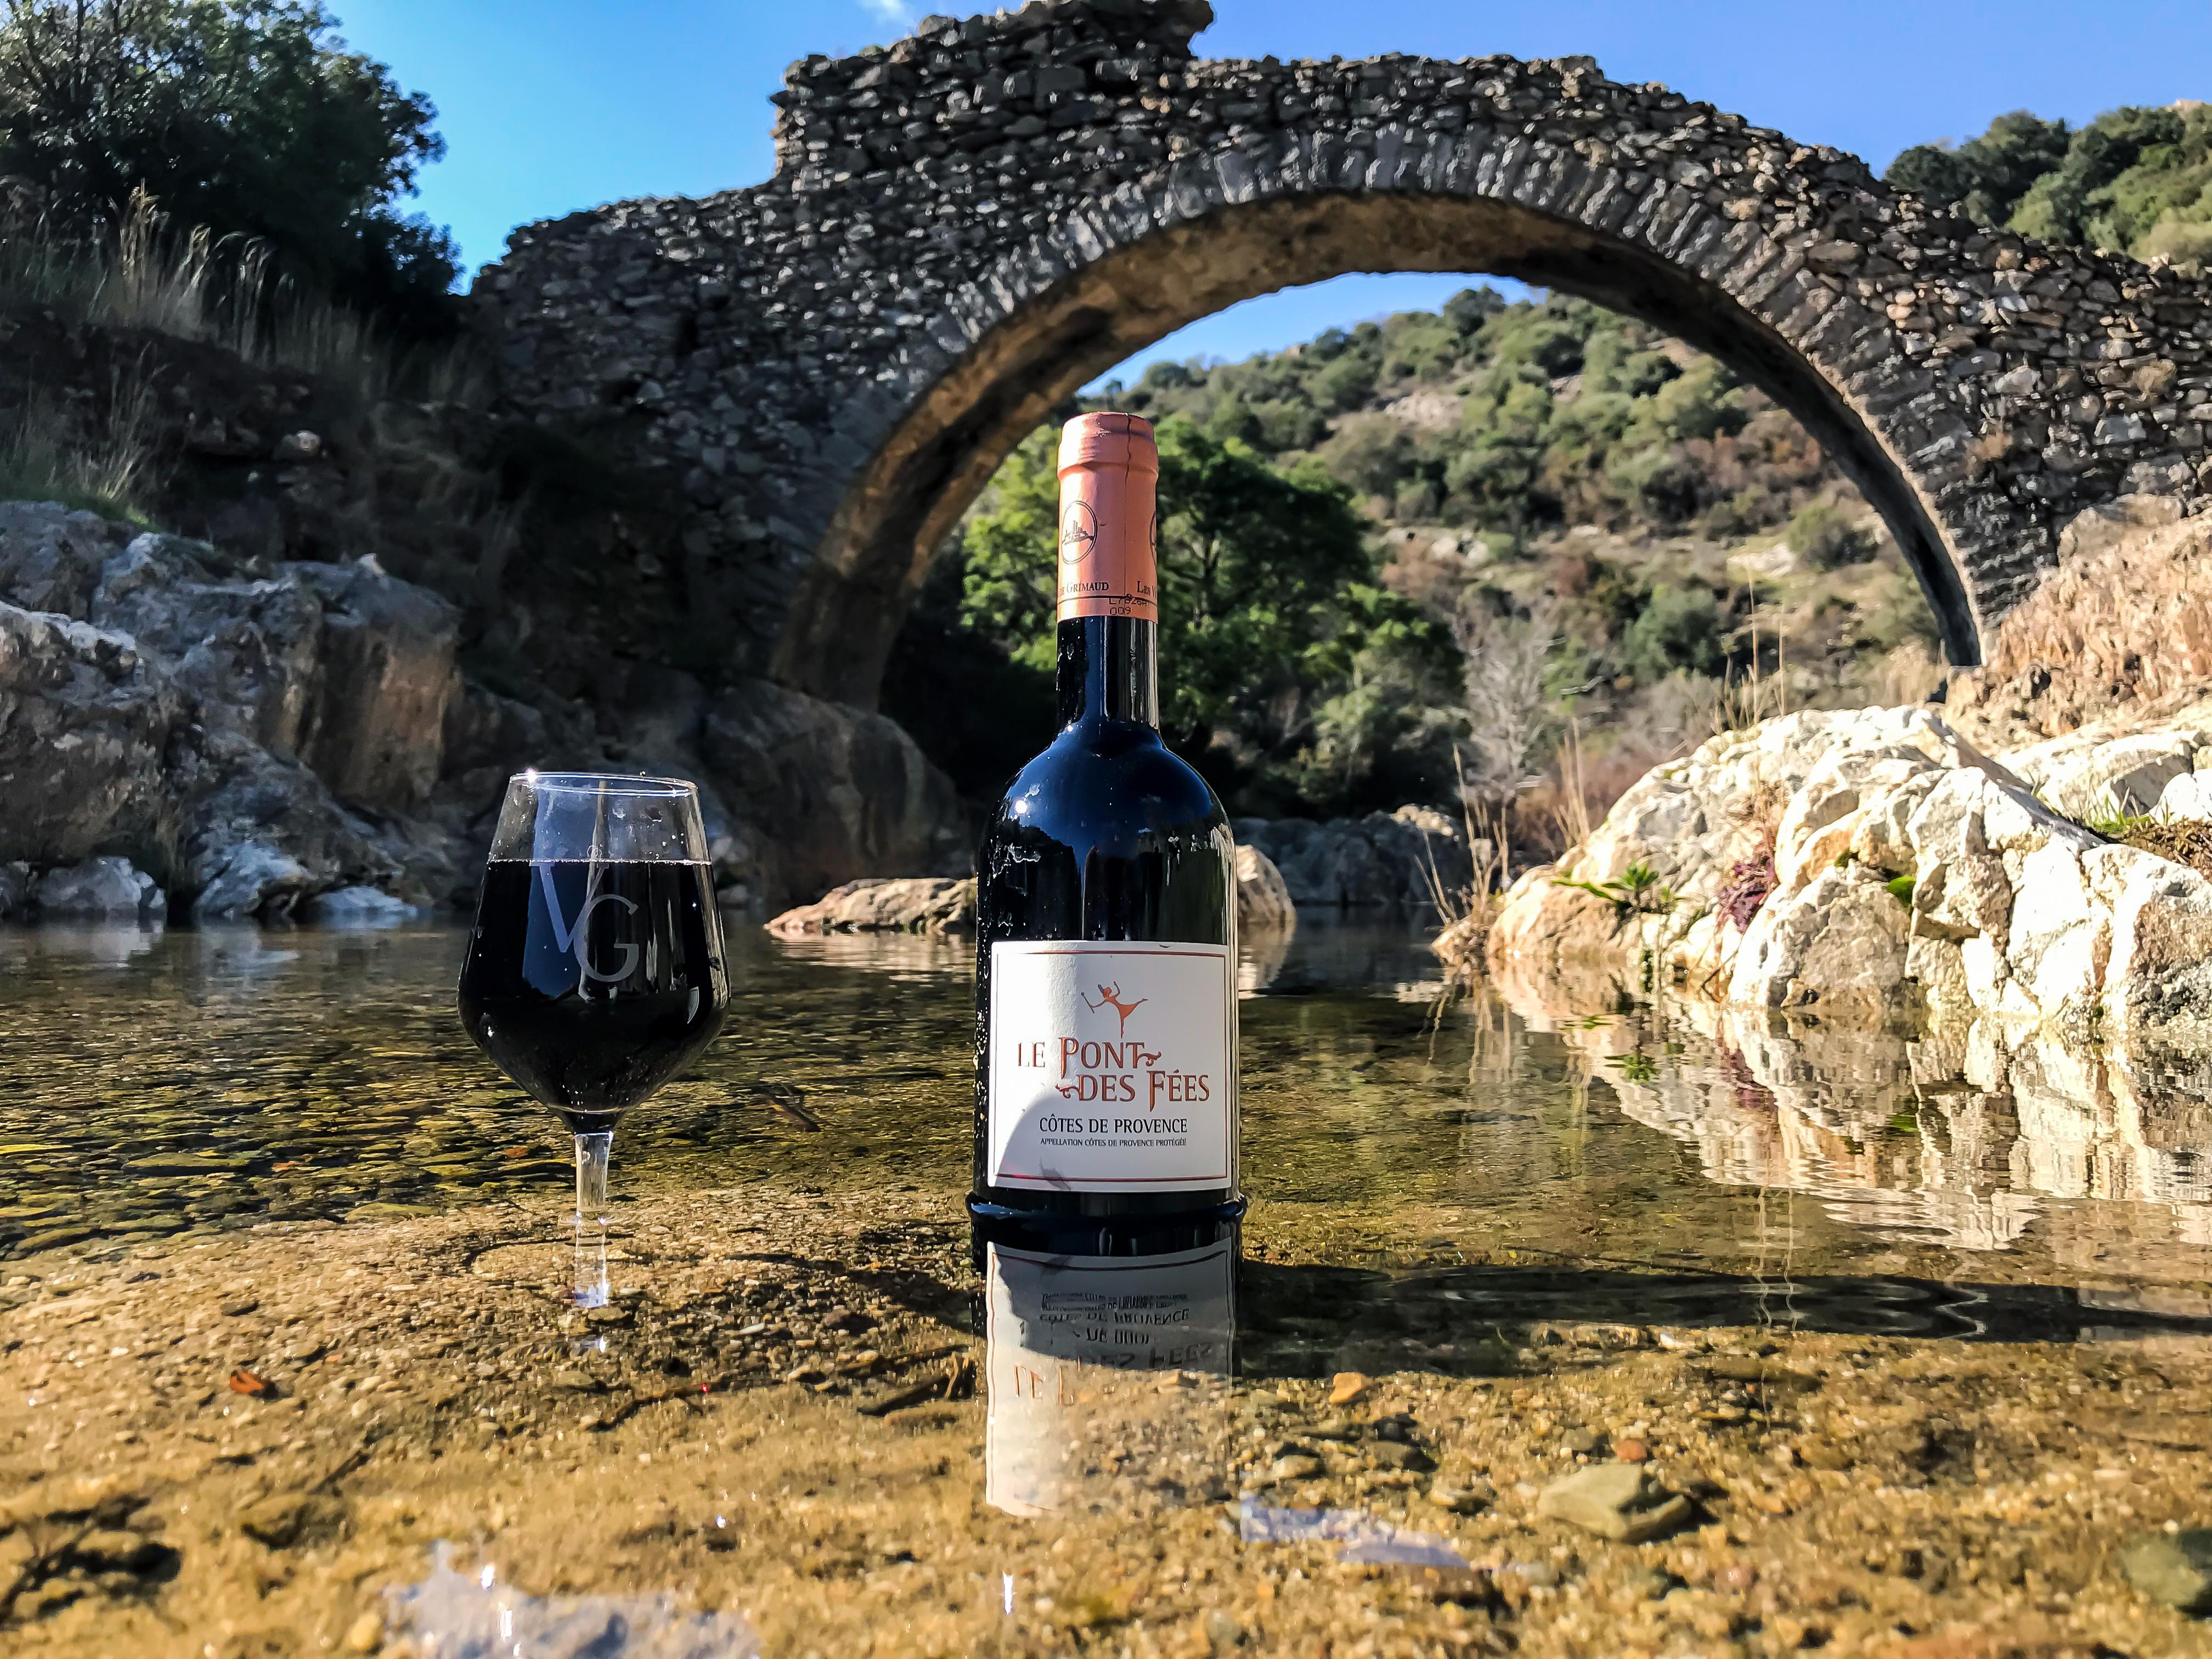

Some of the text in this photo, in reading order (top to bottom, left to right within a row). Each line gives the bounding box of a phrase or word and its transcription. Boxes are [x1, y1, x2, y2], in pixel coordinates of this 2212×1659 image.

[1018, 1036, 1161, 1079] LE PONT
[1056, 1069, 1210, 1112] DES FÉES
[1040, 1113, 1188, 1133] CÔTES DE PROVENCE
[1040, 1138, 1083, 1146] APPELLATION
[1085, 1137, 1106, 1147] CÔTES
